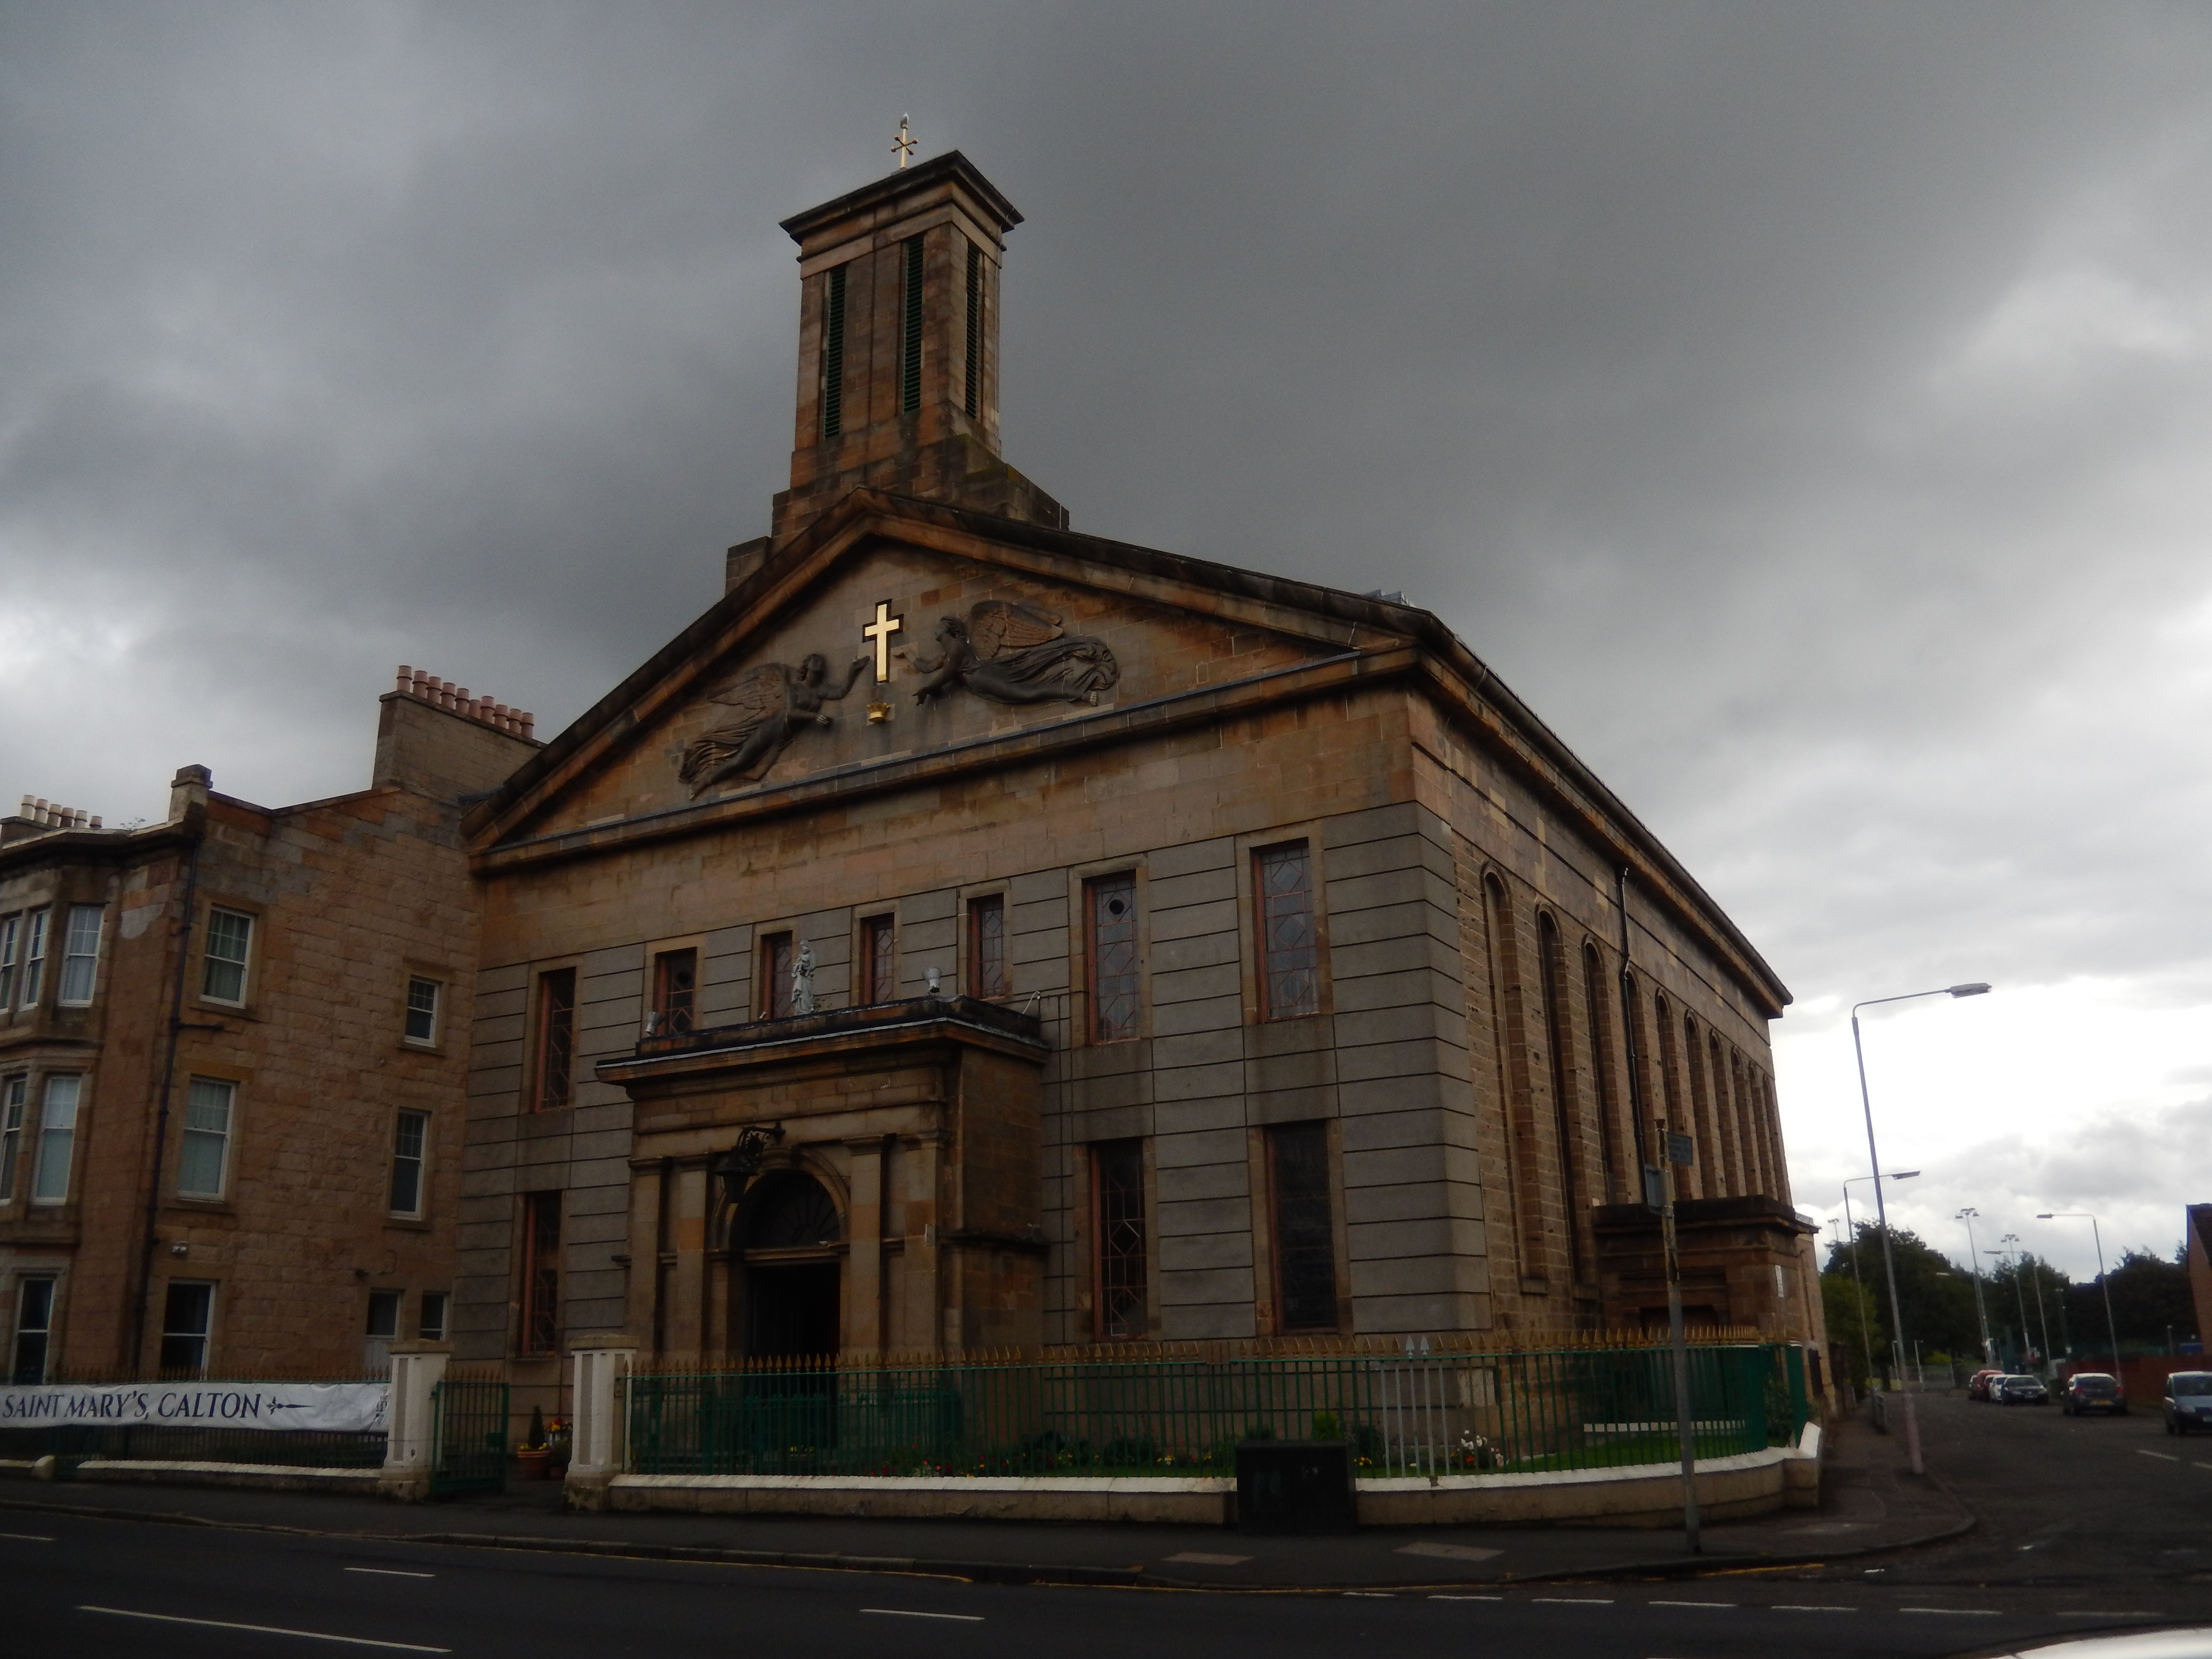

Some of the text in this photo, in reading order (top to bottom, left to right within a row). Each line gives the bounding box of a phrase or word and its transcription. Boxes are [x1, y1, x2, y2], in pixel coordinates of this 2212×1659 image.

[3, 1391, 261, 1419] SAINT MARY'S, CALTON
